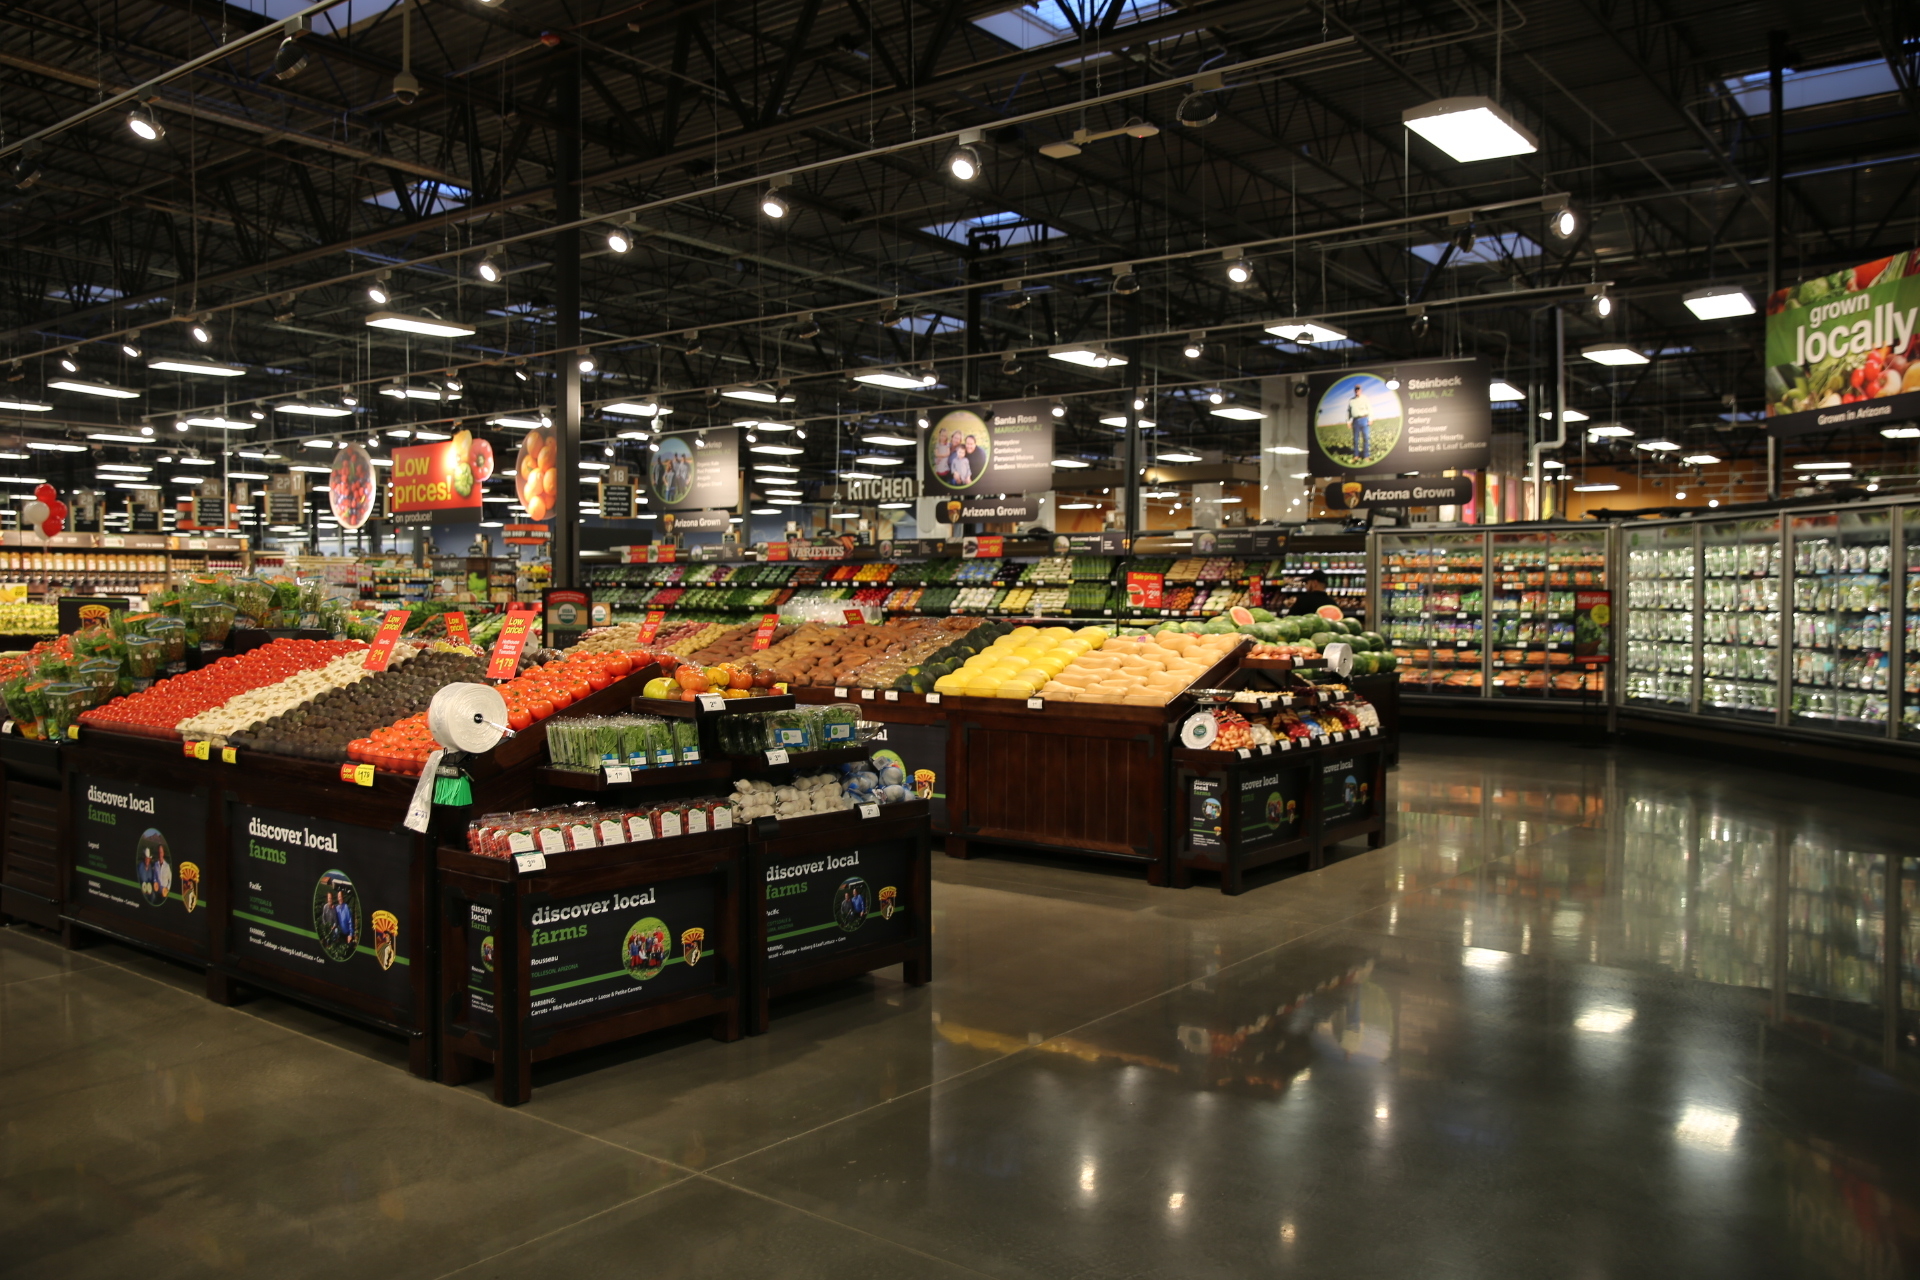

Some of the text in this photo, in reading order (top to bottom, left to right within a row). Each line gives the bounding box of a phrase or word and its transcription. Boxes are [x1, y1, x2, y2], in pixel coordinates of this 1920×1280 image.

[1810, 293, 1870, 329] grown
[1796, 301, 1919, 367] locally
[1408, 376, 1462, 390] Steinbeck
[1408, 389, 1454, 400] YUMA, AZ
[1408, 405, 1437, 415] Broccoli
[1817, 405, 1892, 425] Grown in Arizona
[994, 415, 1037, 426] Santa Rosa
[1408, 416, 1430, 425] Celery
[994, 425, 1030, 434] MARICOPA,
[1408, 425, 1448, 434] Cauliflower
[1408, 445, 1434, 453] Iceberg
[1442, 443, 1457, 451] Leaf
[1459, 441, 1487, 450] Lettuce
[395, 454, 431, 477] Low
[612, 470, 625, 483] 18
[203, 483, 218, 495] 24
[394, 475, 452, 508] prices!
[847, 477, 913, 501] KITCHEN
[1363, 487, 1455, 501] Arizona Grown
[395, 511, 433, 522] on produce!
[962, 505, 1026, 517] Arizona Grown
[674, 518, 721, 528] Arizona Grown
[790, 546, 845, 558] VARIETIES
[1578, 595, 1591, 604] Sale
[387, 614, 402, 623] Low
[448, 617, 460, 626] Low
[508, 616, 524, 626] Low
[383, 620, 401, 632] price!
[449, 624, 465, 633] price!
[504, 624, 526, 636] price!
[1241, 773, 1279, 791] scover local
[87, 784, 154, 814] discover local
[87, 804, 116, 825] farms
[248, 817, 338, 853] discover local
[249, 839, 287, 865] farms
[766, 851, 860, 882] discover local
[249, 881, 262, 891] Pacific
[766, 881, 808, 900] farms
[531, 887, 656, 926] discover local
[471, 911, 488, 923] local
[471, 920, 491, 932] farms
[531, 924, 588, 947] farms
[767, 943, 784, 952] ARMING:
[531, 955, 559, 967] Rousseau
[531, 963, 579, 979] TOLLESON, ARIZONA
[531, 1006, 548, 1017] Carrots
[552, 1003, 562, 1012] Mini
[563, 1000, 579, 1009] Peeled
[579, 996, 594, 1006] Carrots
[598, 992, 611, 1001] Loose
[614, 988, 628, 997] Petite
[627, 985, 642, 994] Carrots
[531, 997, 557, 1009] FARMING:
